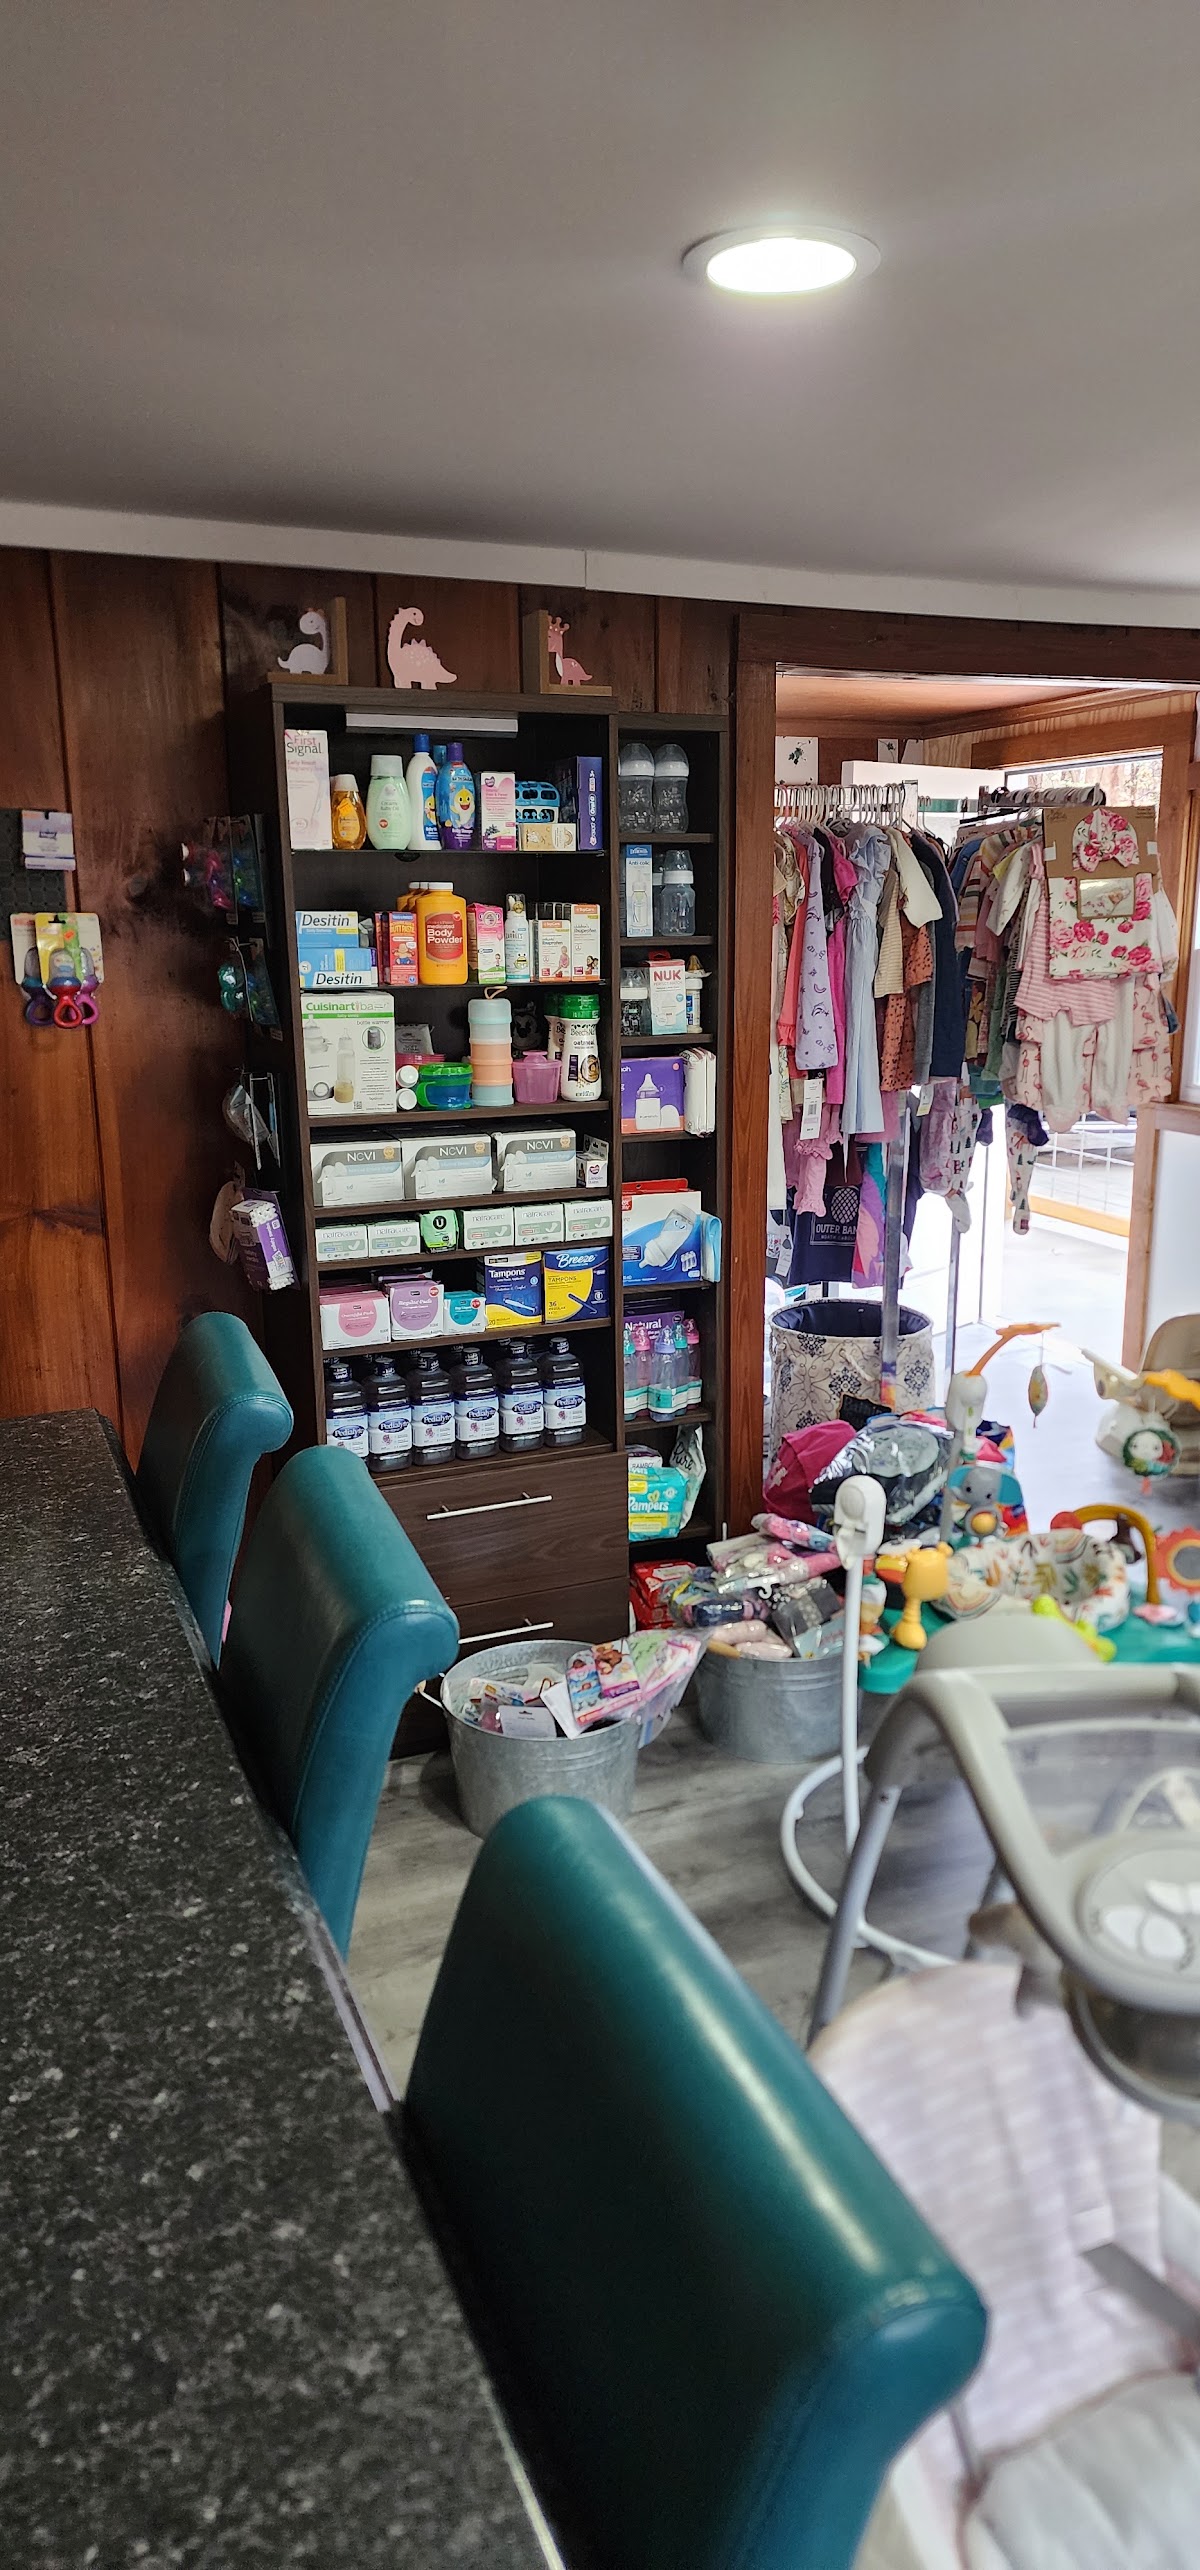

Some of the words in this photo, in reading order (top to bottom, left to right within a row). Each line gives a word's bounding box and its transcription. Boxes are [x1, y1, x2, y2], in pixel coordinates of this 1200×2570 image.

[294, 737, 316, 745] First
[286, 742, 322, 756] Signal
[302, 914, 350, 927] Desitin
[427, 929, 453, 937] Body
[427, 936, 463, 944] Powder
[316, 972, 362, 985] Desitin
[653, 969, 682, 981] NUK
[306, 1002, 355, 1011] Cuisinart
[527, 1140, 553, 1150] NCVI
[347, 1151, 376, 1162] NCVI
[439, 1146, 467, 1157] NCVI
[522, 1210, 555, 1218] natracare
[573, 1205, 604, 1214] natracare
[472, 1214, 505, 1222] natracare
[323, 1230, 358, 1239] natracare
[376, 1227, 411, 1236] natracare
[816, 1224, 840, 1233] OUTER
[842, 1226, 857, 1235] BAN
[556, 1254, 596, 1268] Breeze
[489, 1269, 526, 1278] Tampons
[673, 1441, 694, 1470] Pure
[629, 1496, 669, 1513] Pampers
